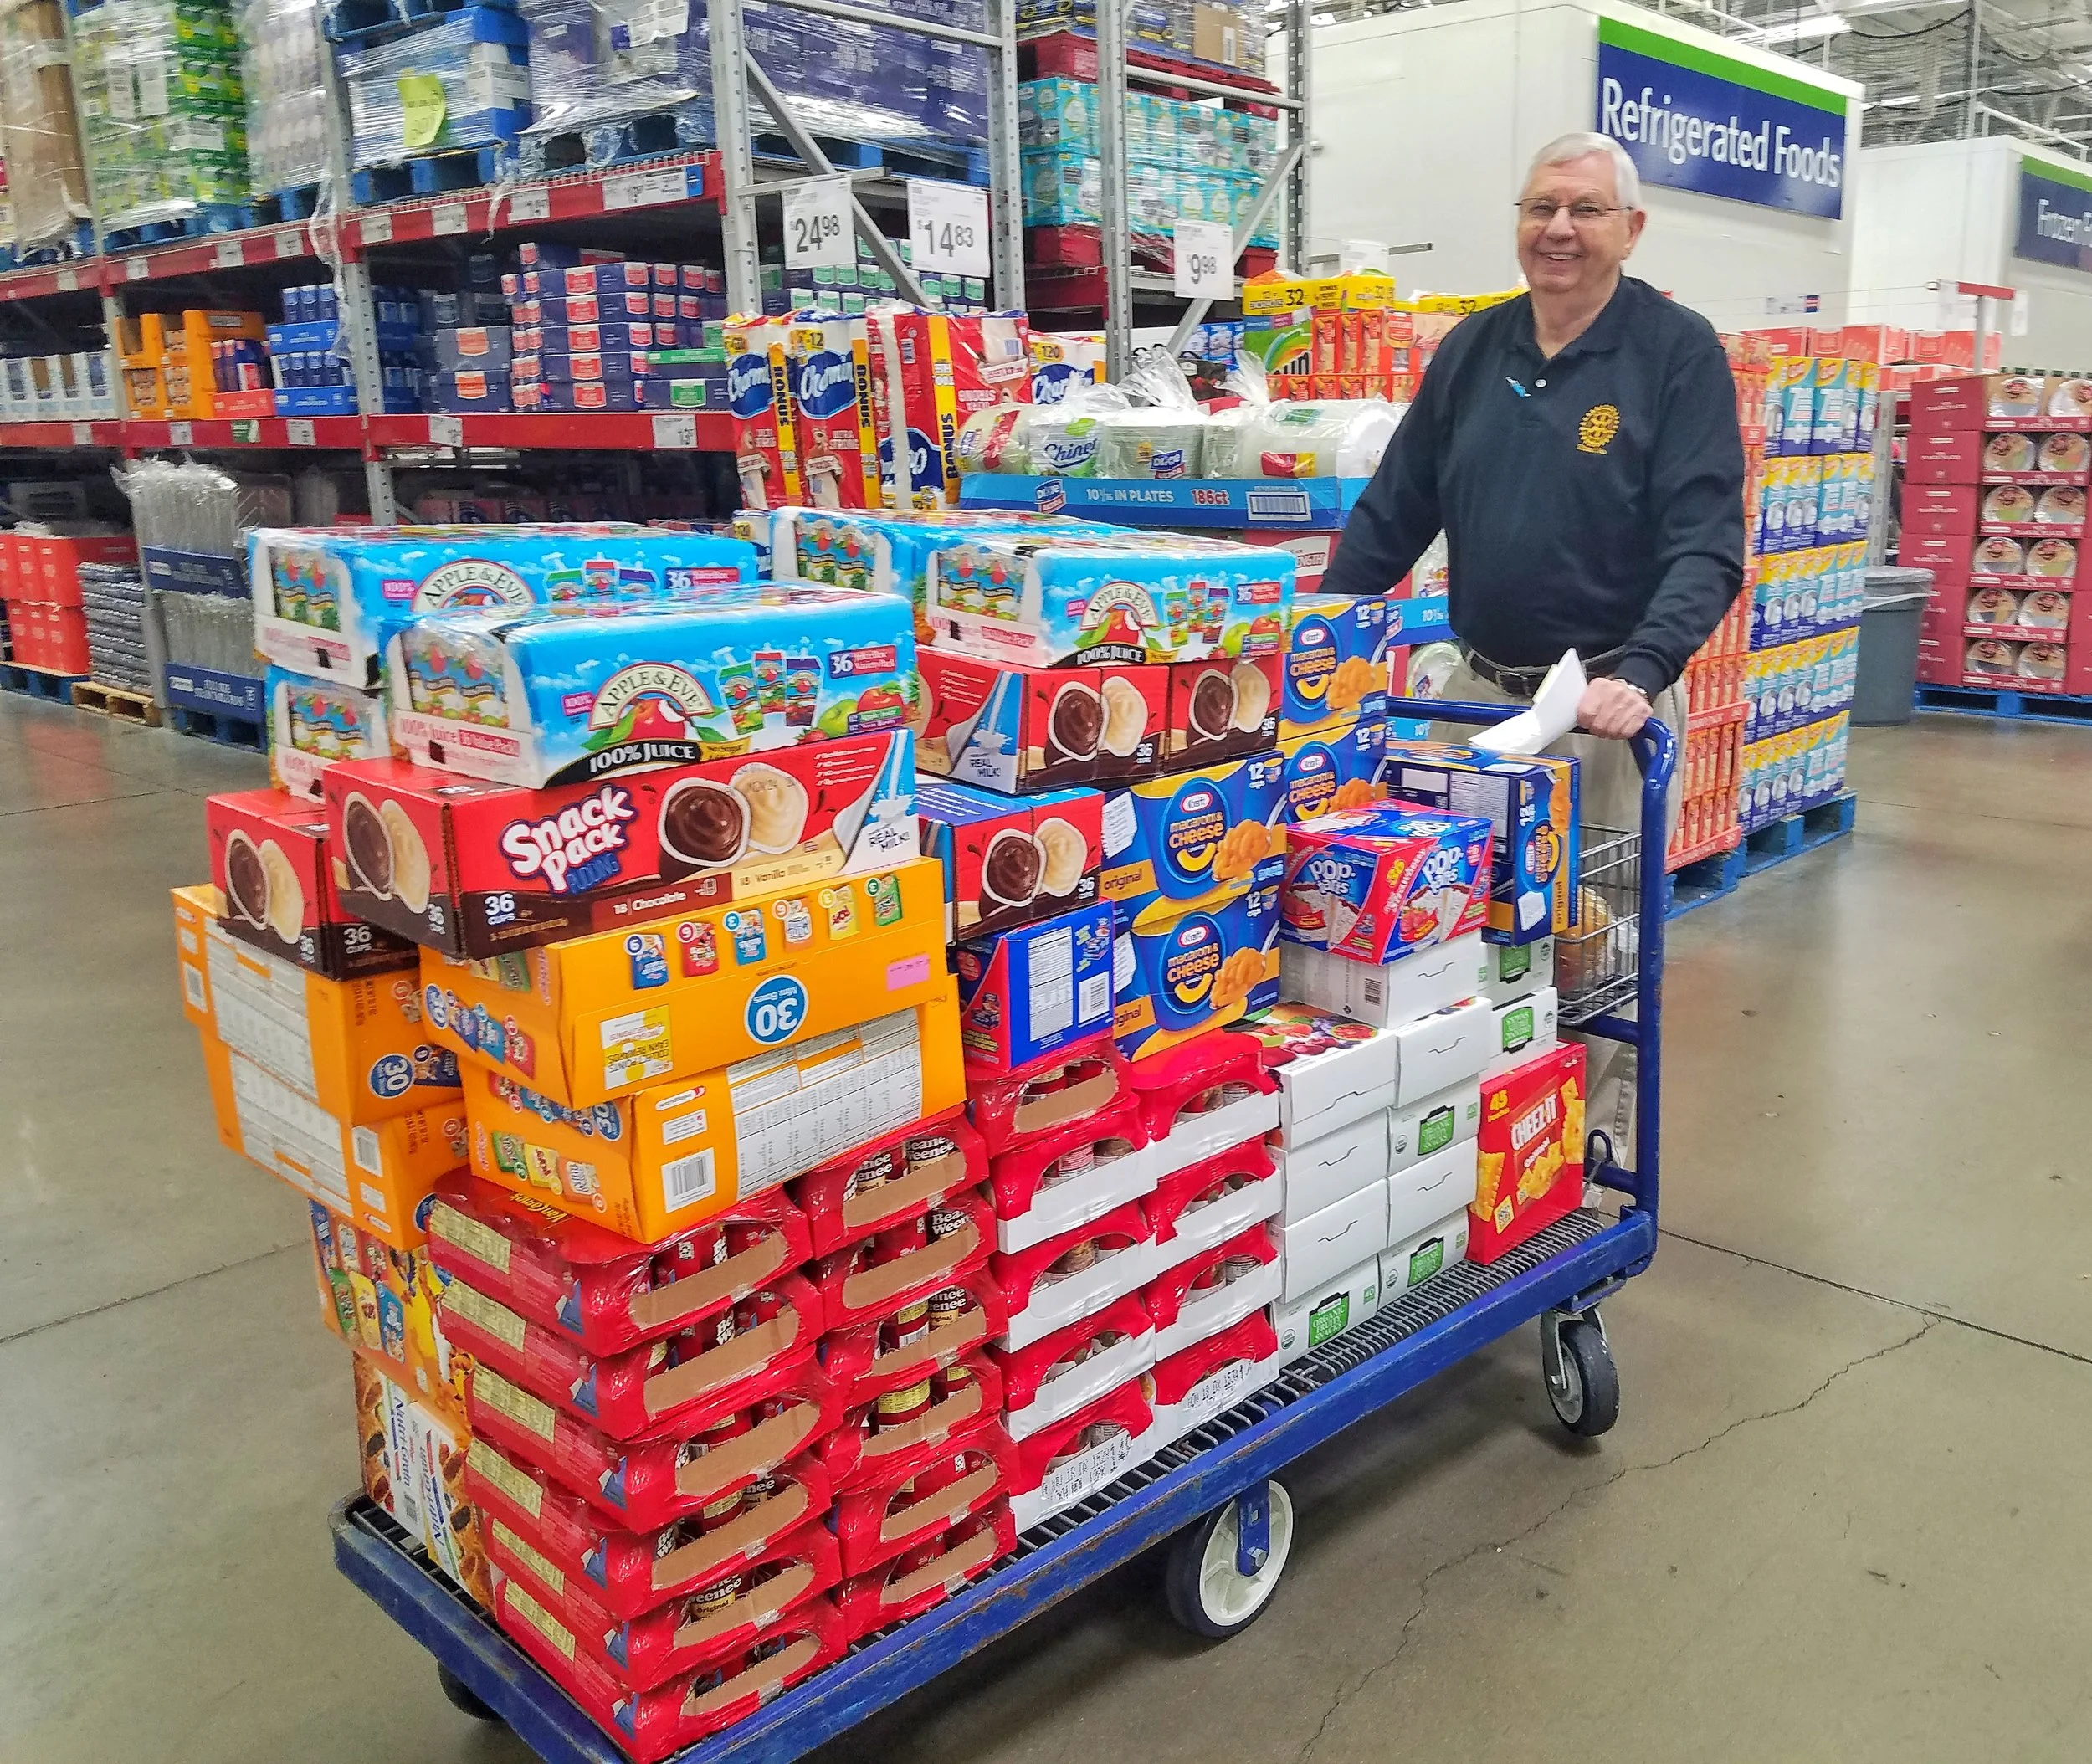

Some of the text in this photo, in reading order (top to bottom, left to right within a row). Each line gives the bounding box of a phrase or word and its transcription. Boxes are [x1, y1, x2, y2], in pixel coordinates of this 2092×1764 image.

[1601, 77, 1841, 187] Refrigerated Foods
[1285, 288, 1305, 306] 32
[773, 365, 790, 427] BONUS
[856, 363, 872, 428] BONUS
[941, 413, 959, 480] BONUS
[1115, 490, 1127, 501] IN
[1130, 490, 1174, 502] PLATES
[1191, 488, 1231, 505] 186ct
[1296, 551, 1325, 569] ENGTH
[666, 570, 691, 587] 36
[1356, 604, 1370, 621] 12
[831, 654, 853, 674] 36
[598, 670, 651, 718] APPLE
[669, 673, 698, 708] EVE
[1355, 727, 1370, 744] 12
[588, 742, 696, 773] 100% JUICE
[1136, 743, 1154, 757] 36
[1247, 761, 1264, 780] 12
[1519, 807, 1531, 827] 12
[502, 786, 634, 874] Snack
[1078, 876, 1095, 892] 36
[1103, 868, 1143, 891] original
[484, 892, 515, 915] 36
[631, 891, 687, 911] Chocolate
[1245, 891, 1261, 910] 12
[1554, 880, 1563, 925] original
[344, 926, 372, 945] 36
[754, 997, 799, 1037] 30
[1114, 1004, 1142, 1027] iginal
[384, 1059, 409, 1090] 30
[1490, 1089, 1509, 1111] 45
[1312, 1304, 1346, 1328] ORGANIC
